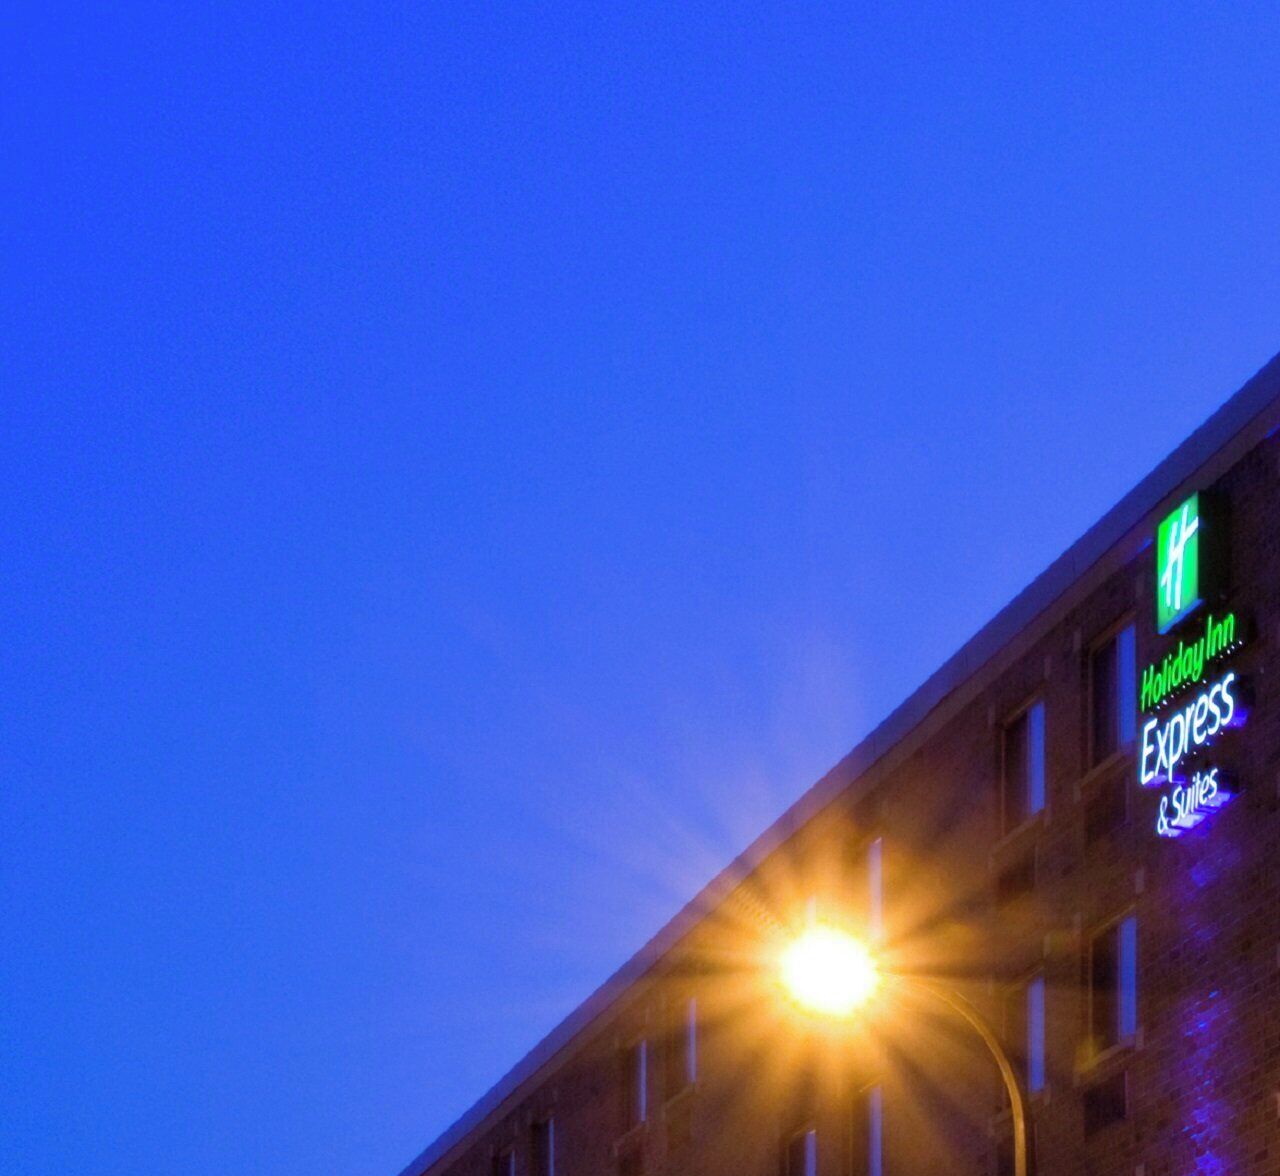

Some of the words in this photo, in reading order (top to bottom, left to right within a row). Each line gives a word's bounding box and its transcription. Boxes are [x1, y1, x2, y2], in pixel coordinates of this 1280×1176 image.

[1141, 641, 1205, 713] Holiday
[1206, 613, 1235, 660] Inn
[1140, 673, 1236, 786] Express
[1157, 797, 1170, 836] &
[1171, 768, 1219, 824] Suites
